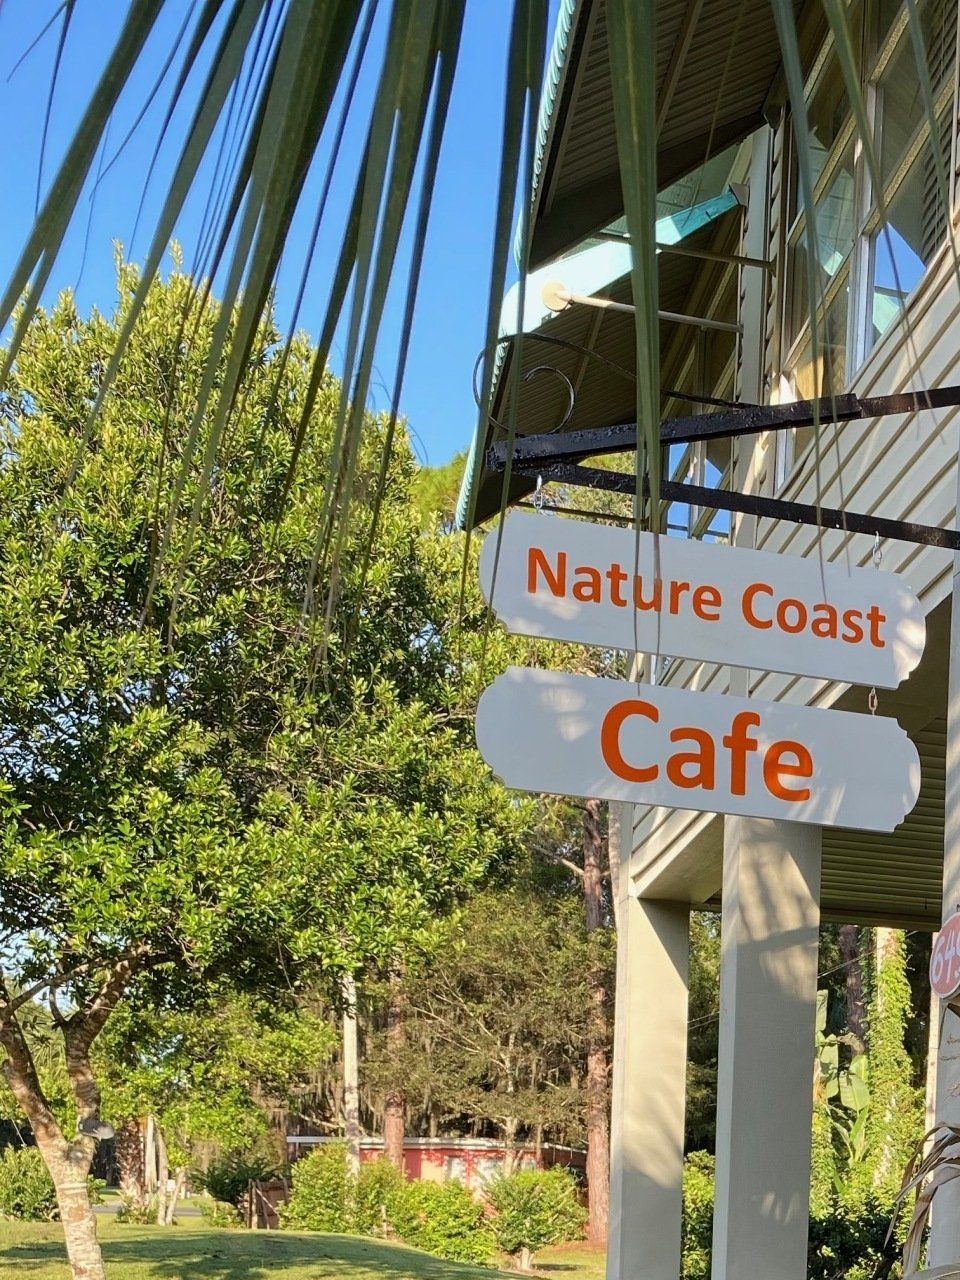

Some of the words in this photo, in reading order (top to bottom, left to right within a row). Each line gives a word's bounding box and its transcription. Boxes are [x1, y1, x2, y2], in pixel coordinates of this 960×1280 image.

[527, 547, 722, 622] Nature
[741, 583, 886, 648] Coast
[600, 699, 814, 802] Cafe
